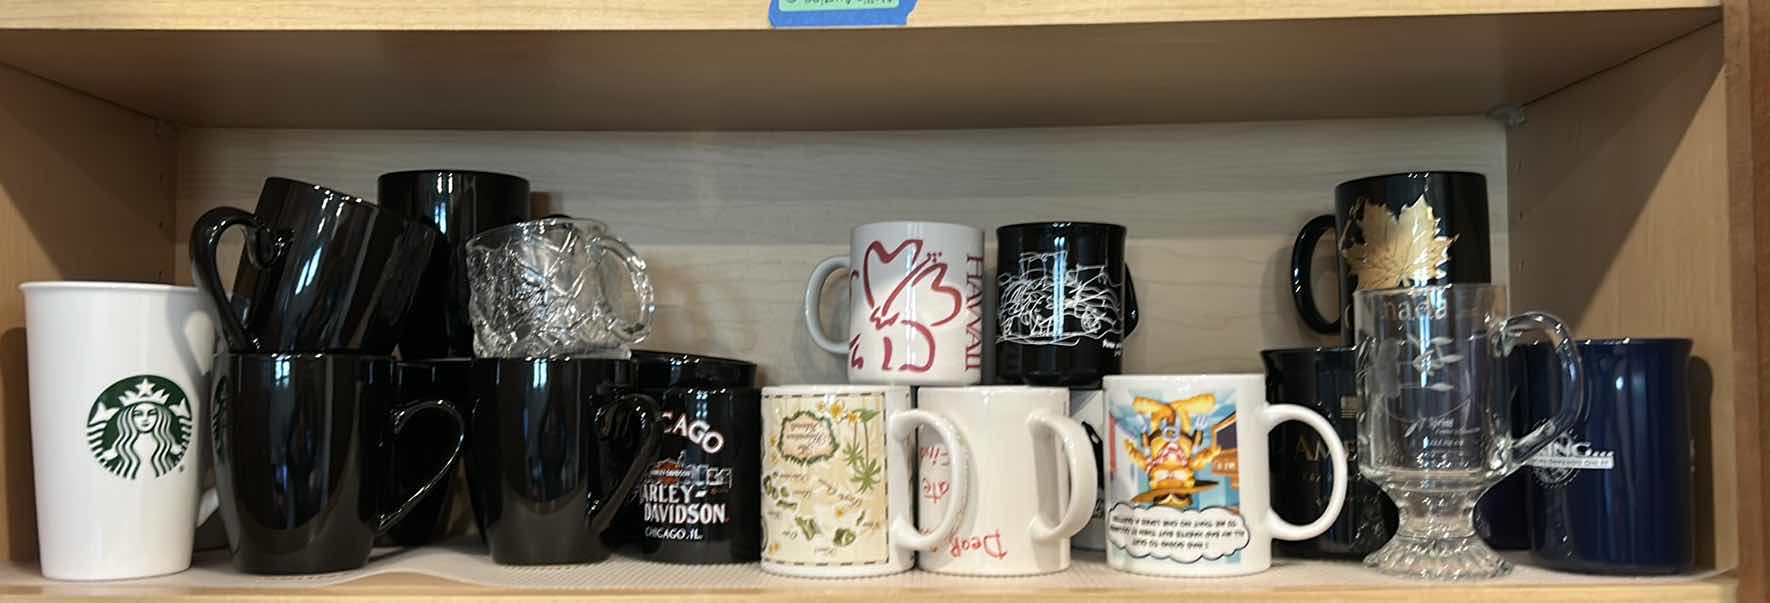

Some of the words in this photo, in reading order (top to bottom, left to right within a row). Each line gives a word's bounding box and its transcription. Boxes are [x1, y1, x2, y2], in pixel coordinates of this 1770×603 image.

[965, 252, 983, 372] HAWAII
[640, 484, 707, 504] ARLEY-
[644, 503, 726, 525] DAVIDSON
